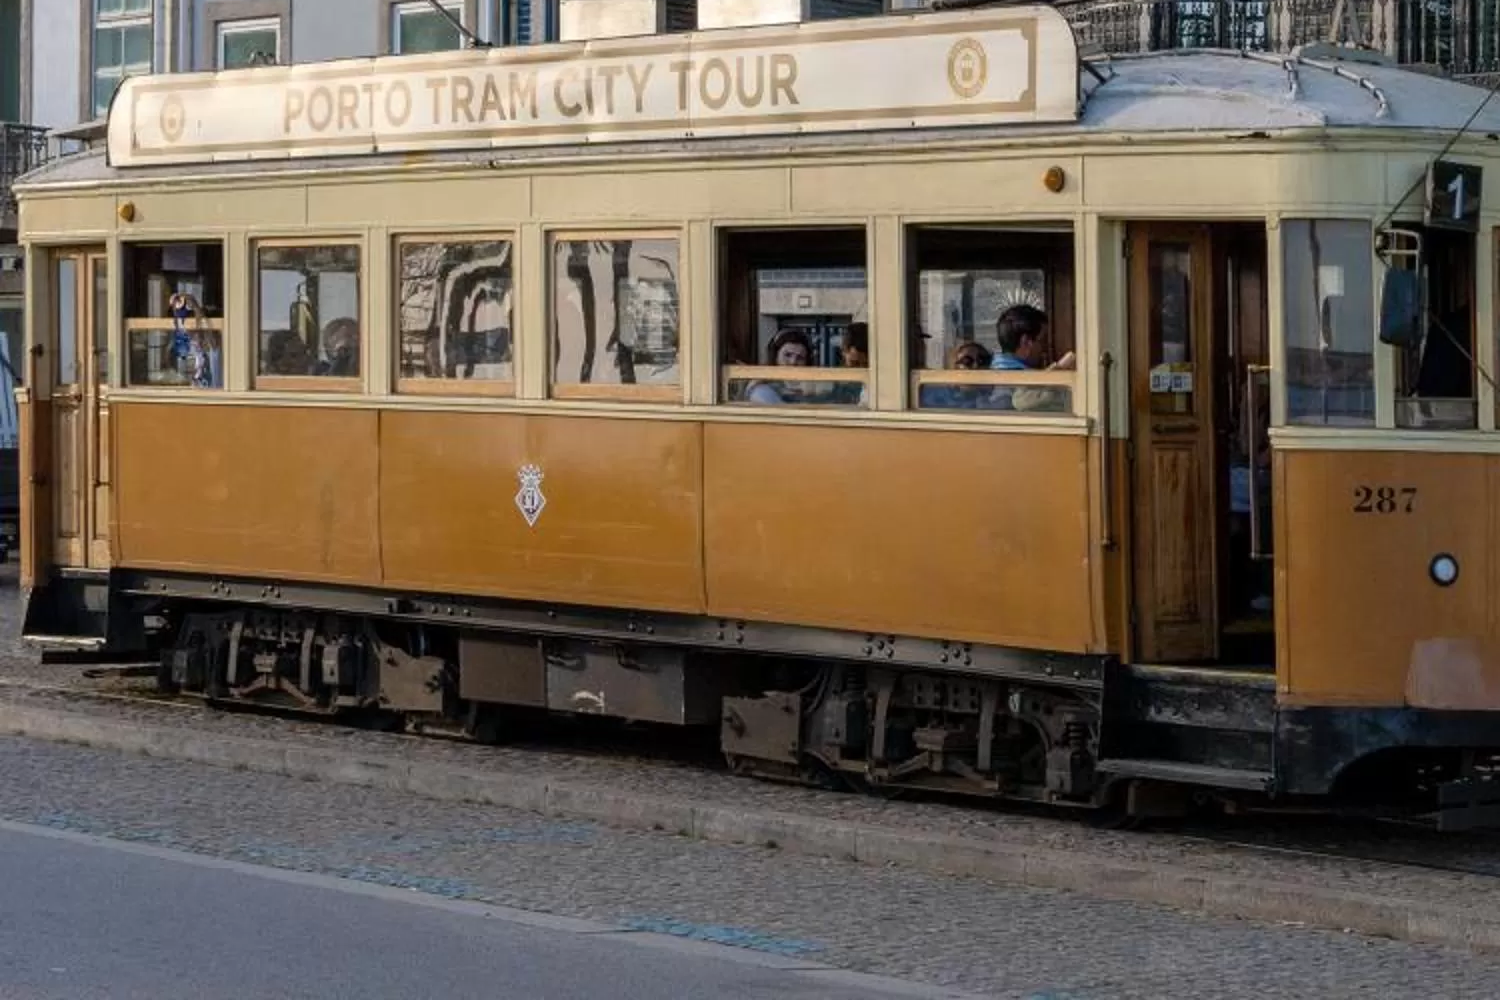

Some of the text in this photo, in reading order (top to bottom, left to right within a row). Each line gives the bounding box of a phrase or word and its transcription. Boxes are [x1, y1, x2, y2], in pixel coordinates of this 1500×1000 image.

[283, 52, 801, 134] PORTO TRAM CITY TOUR
[1447, 172, 1465, 220] 1
[1353, 485, 1418, 513] 287
